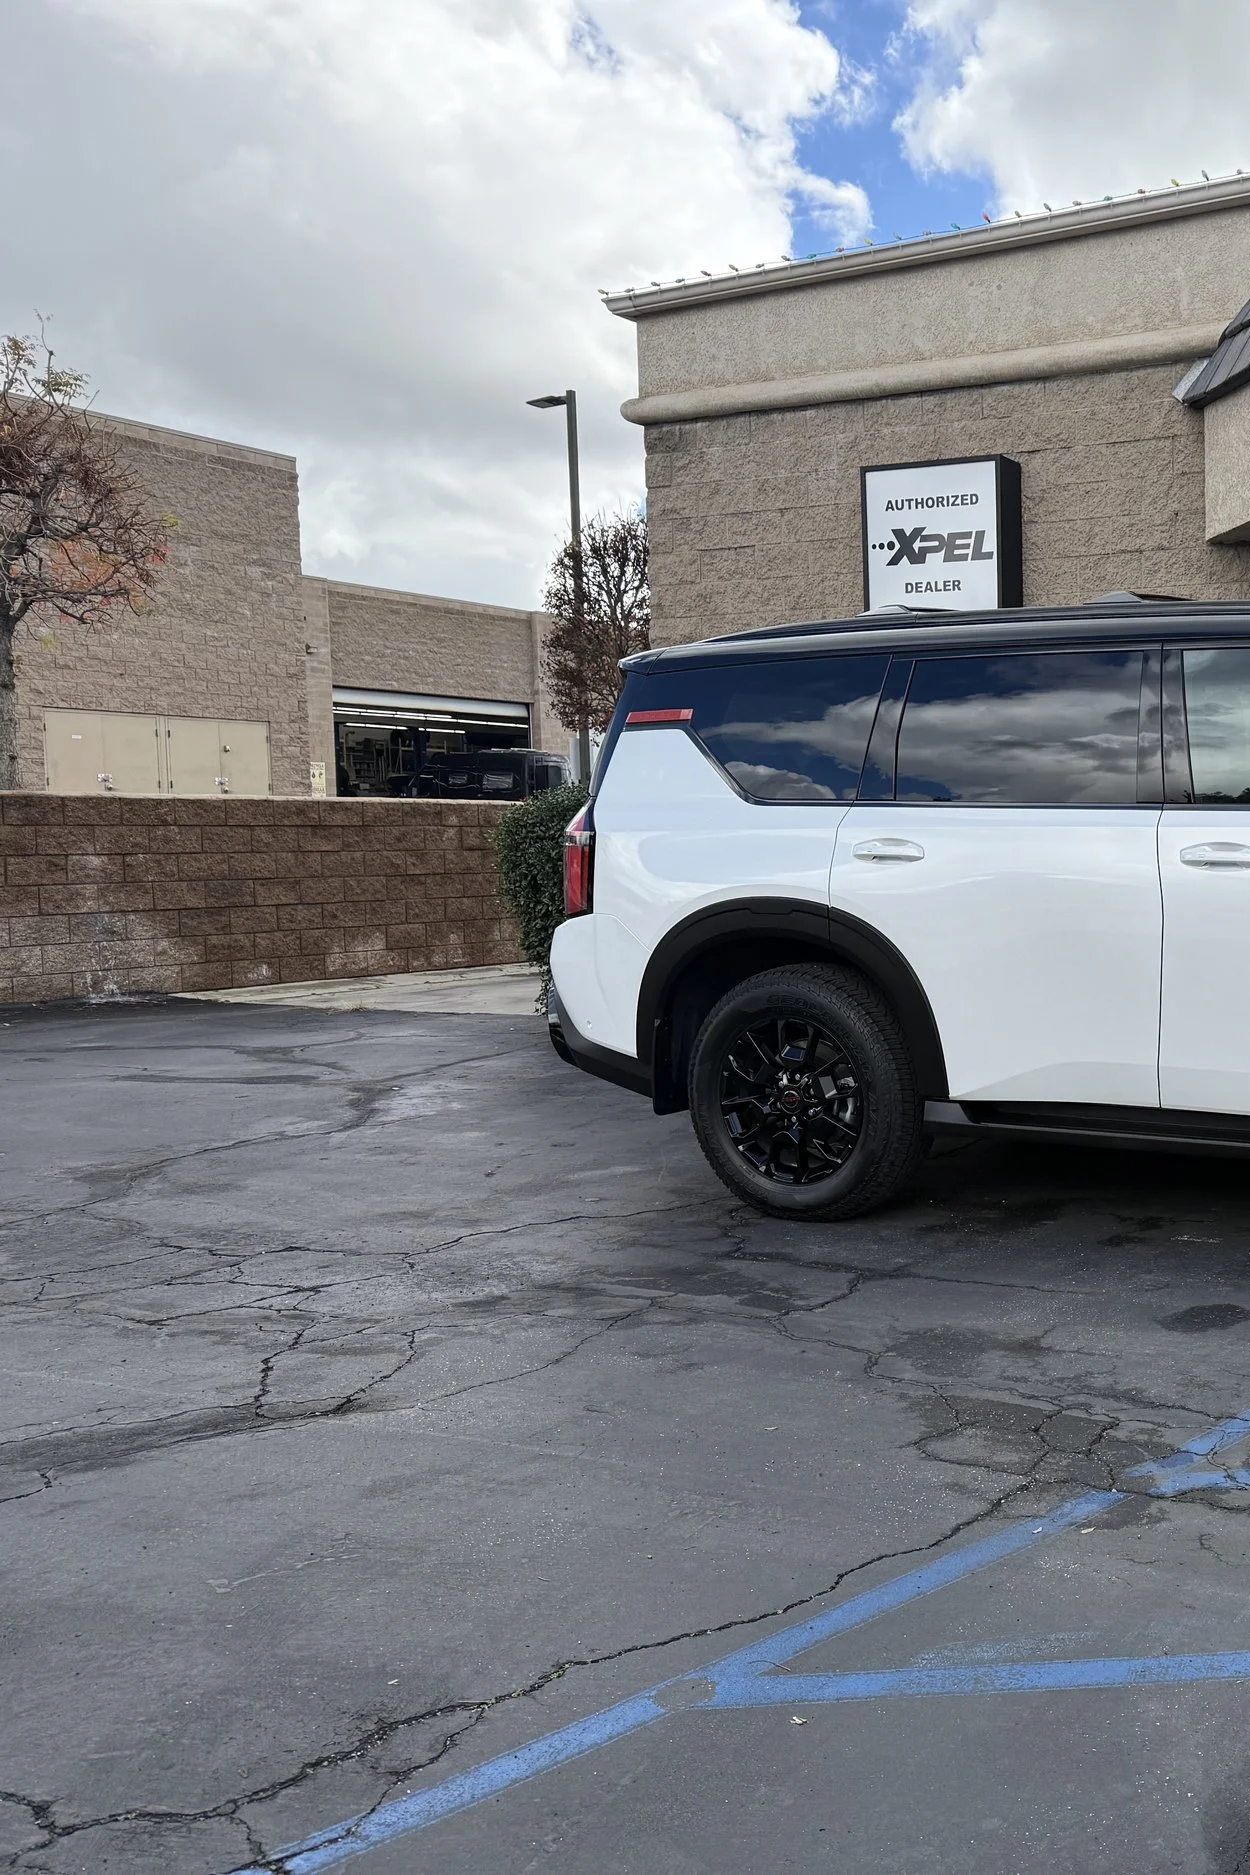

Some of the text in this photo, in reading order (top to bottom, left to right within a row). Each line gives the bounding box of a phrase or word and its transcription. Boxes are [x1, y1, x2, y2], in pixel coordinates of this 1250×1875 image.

[884, 493, 979, 512] AUTHORIZED
[886, 526, 994, 567] XPEL
[904, 579, 962, 594] DEALER
